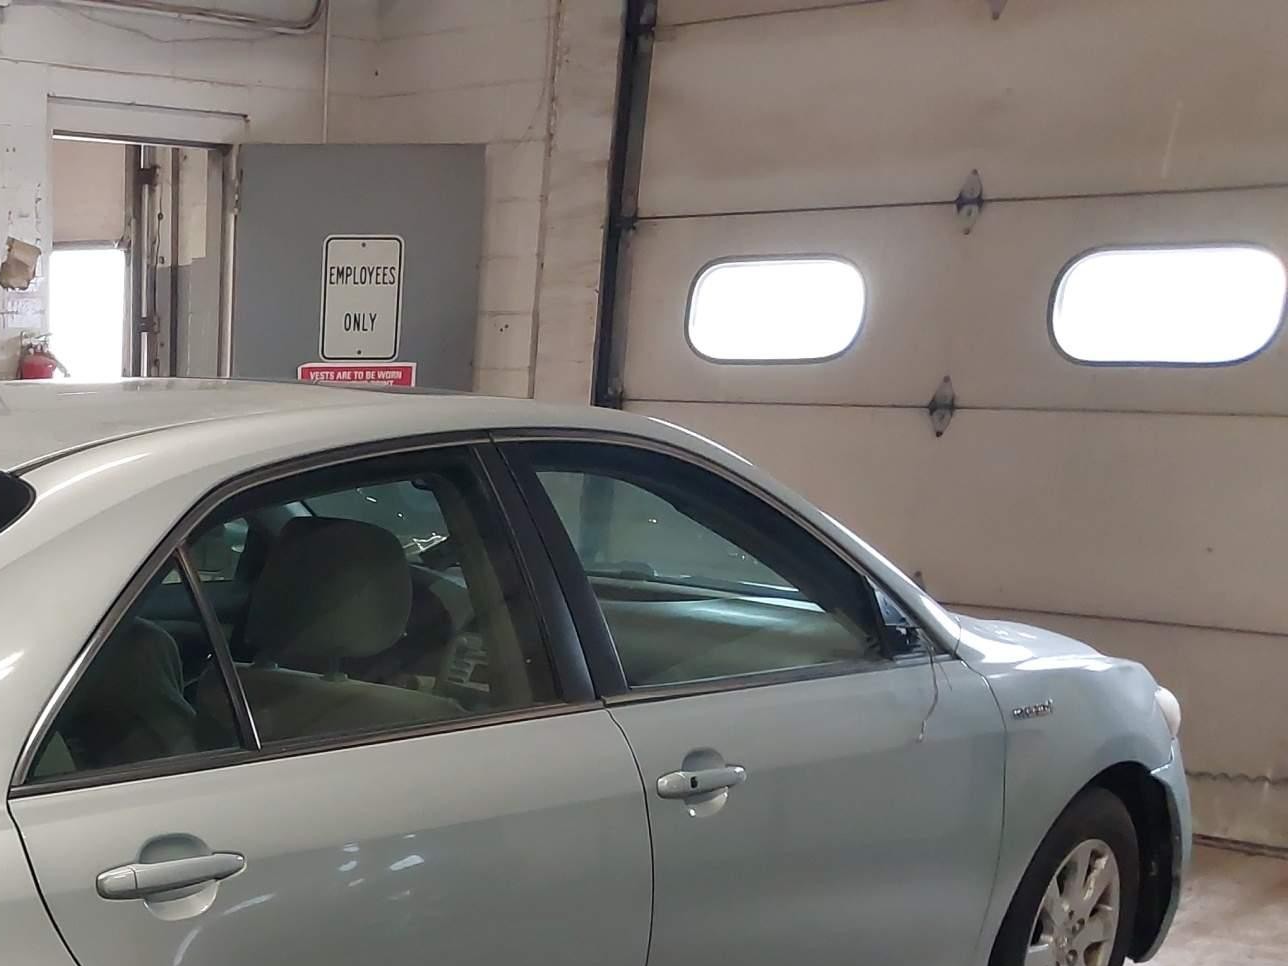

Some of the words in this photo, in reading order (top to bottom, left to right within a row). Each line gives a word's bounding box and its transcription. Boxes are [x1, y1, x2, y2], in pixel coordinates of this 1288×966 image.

[329, 266, 396, 285] EMPLOYEES
[343, 313, 377, 331] ONLY
[310, 371, 335, 380] VESTS
[336, 371, 352, 380] ARE
[354, 371, 364, 380] TO
[365, 371, 376, 380] BE
[377, 371, 402, 380] WORN
